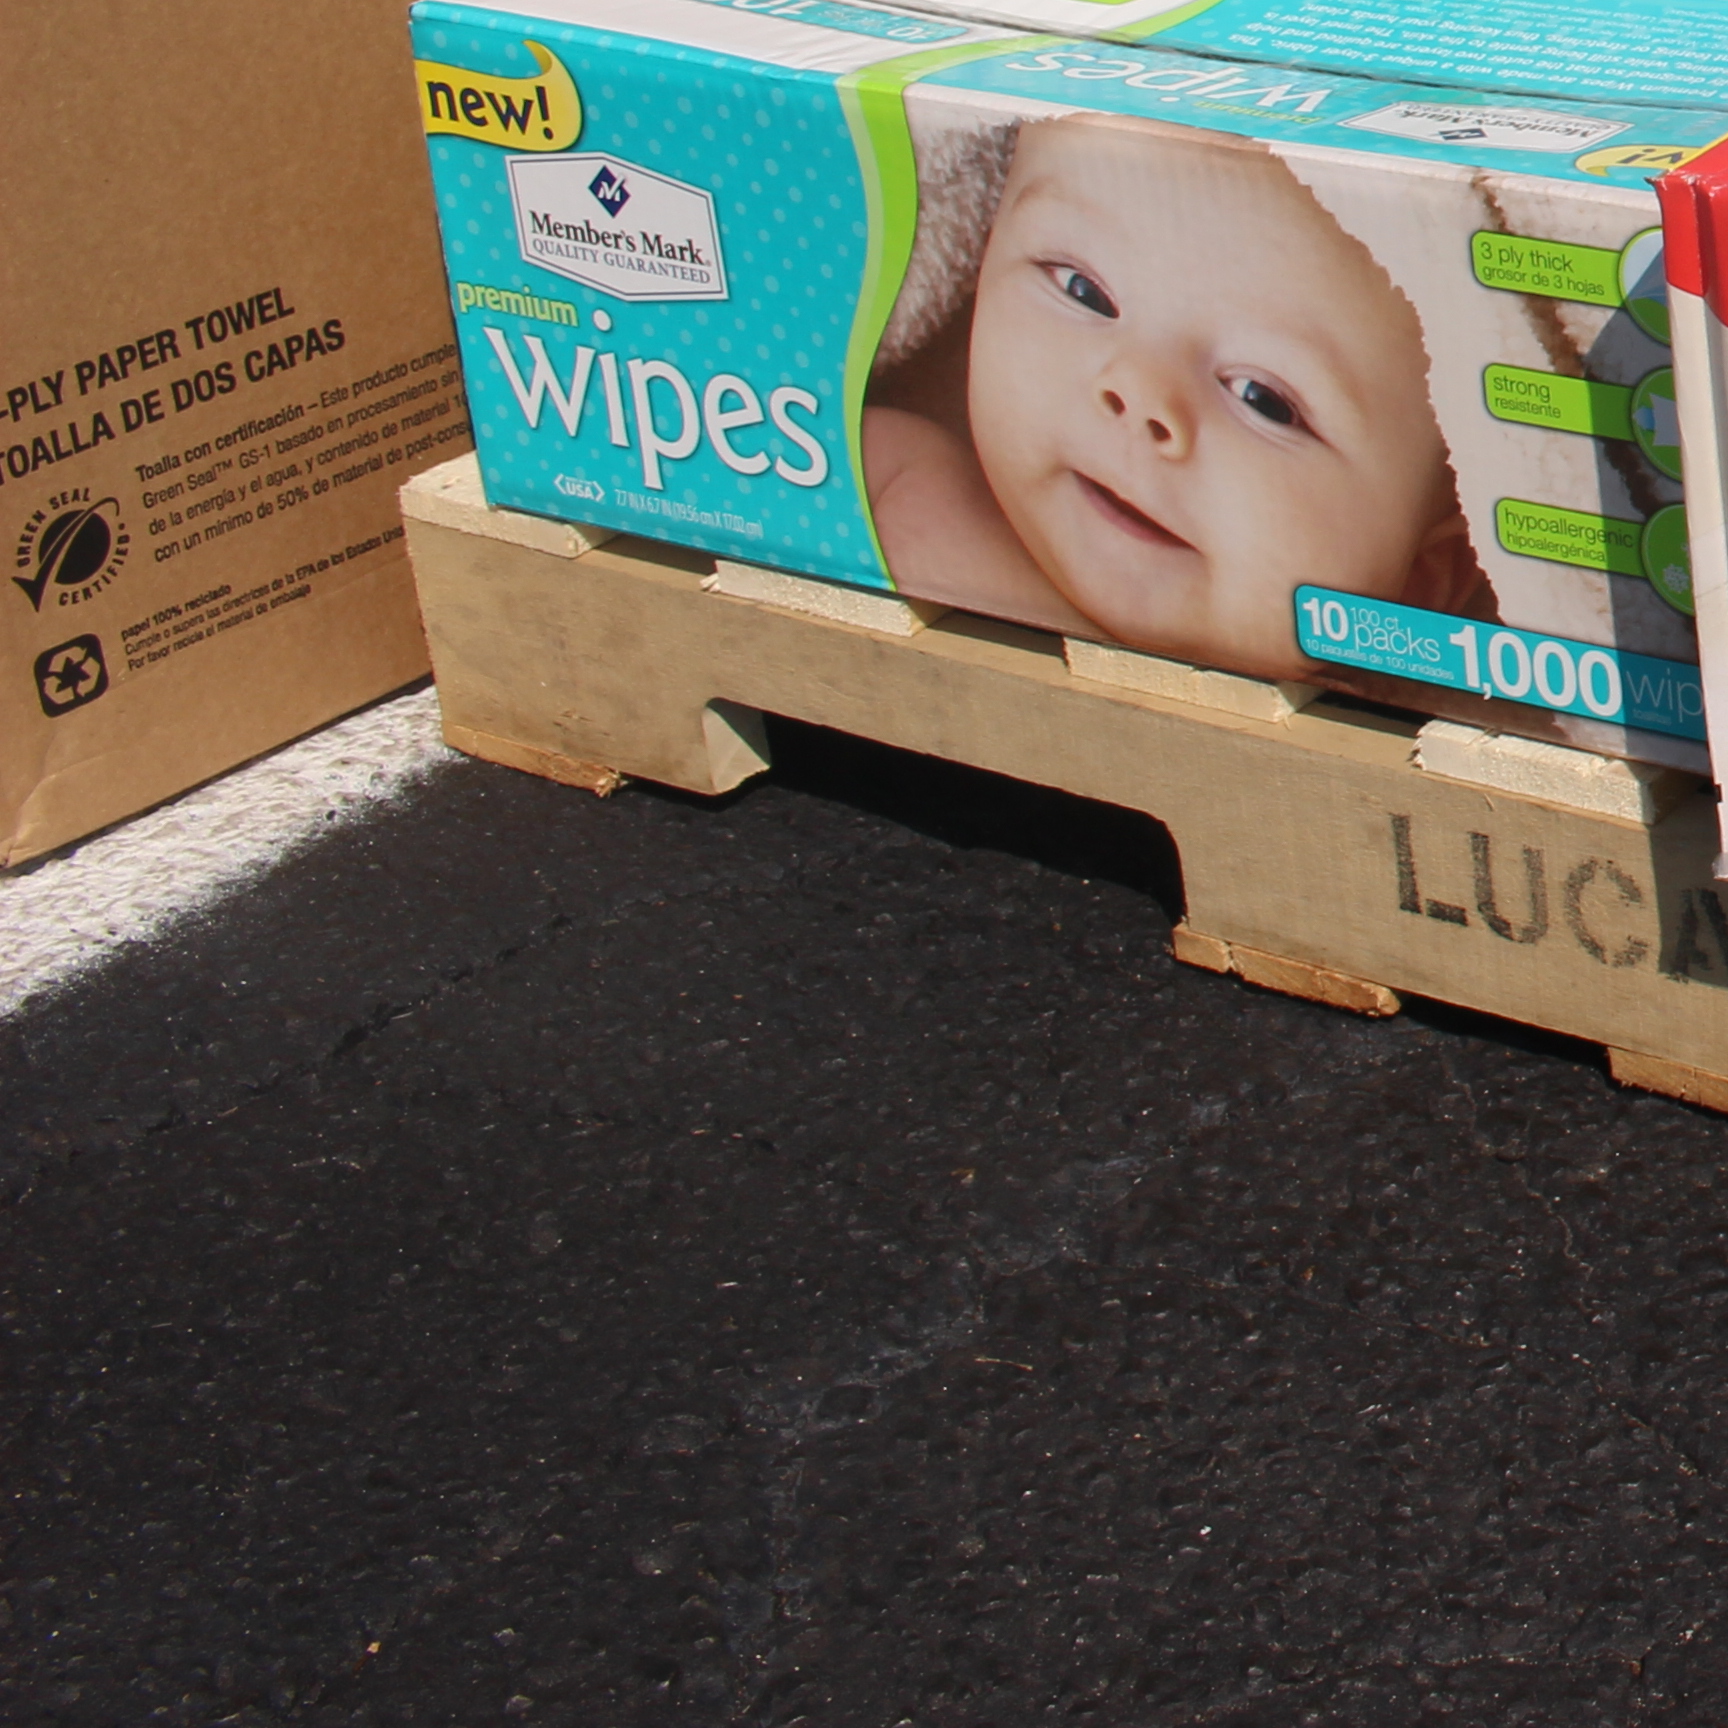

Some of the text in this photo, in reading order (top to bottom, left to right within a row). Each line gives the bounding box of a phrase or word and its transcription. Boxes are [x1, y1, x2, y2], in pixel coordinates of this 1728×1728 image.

[426, 80, 555, 141] new!
[528, 210, 705, 265] Member's Mark
[532, 237, 711, 285] QUALITY GUARANTEED
[1480, 240, 1575, 274] 3 ply thick
[457, 280, 579, 328] premium
[74, 286, 297, 396] PAPER TOWEL
[120, 318, 347, 434] DE DOS CAPAS
[484, 308, 829, 490] Wipes
[1492, 374, 1552, 403] strong
[135, 362, 409, 484] Toalla con certificación Este producto
[1493, 394, 1563, 420] resistente
[1504, 506, 1635, 550] hypoallergenic
[1302, 595, 1349, 643] 10
[1353, 618, 1441, 664] packs
[1450, 623, 1624, 718] 1,000
